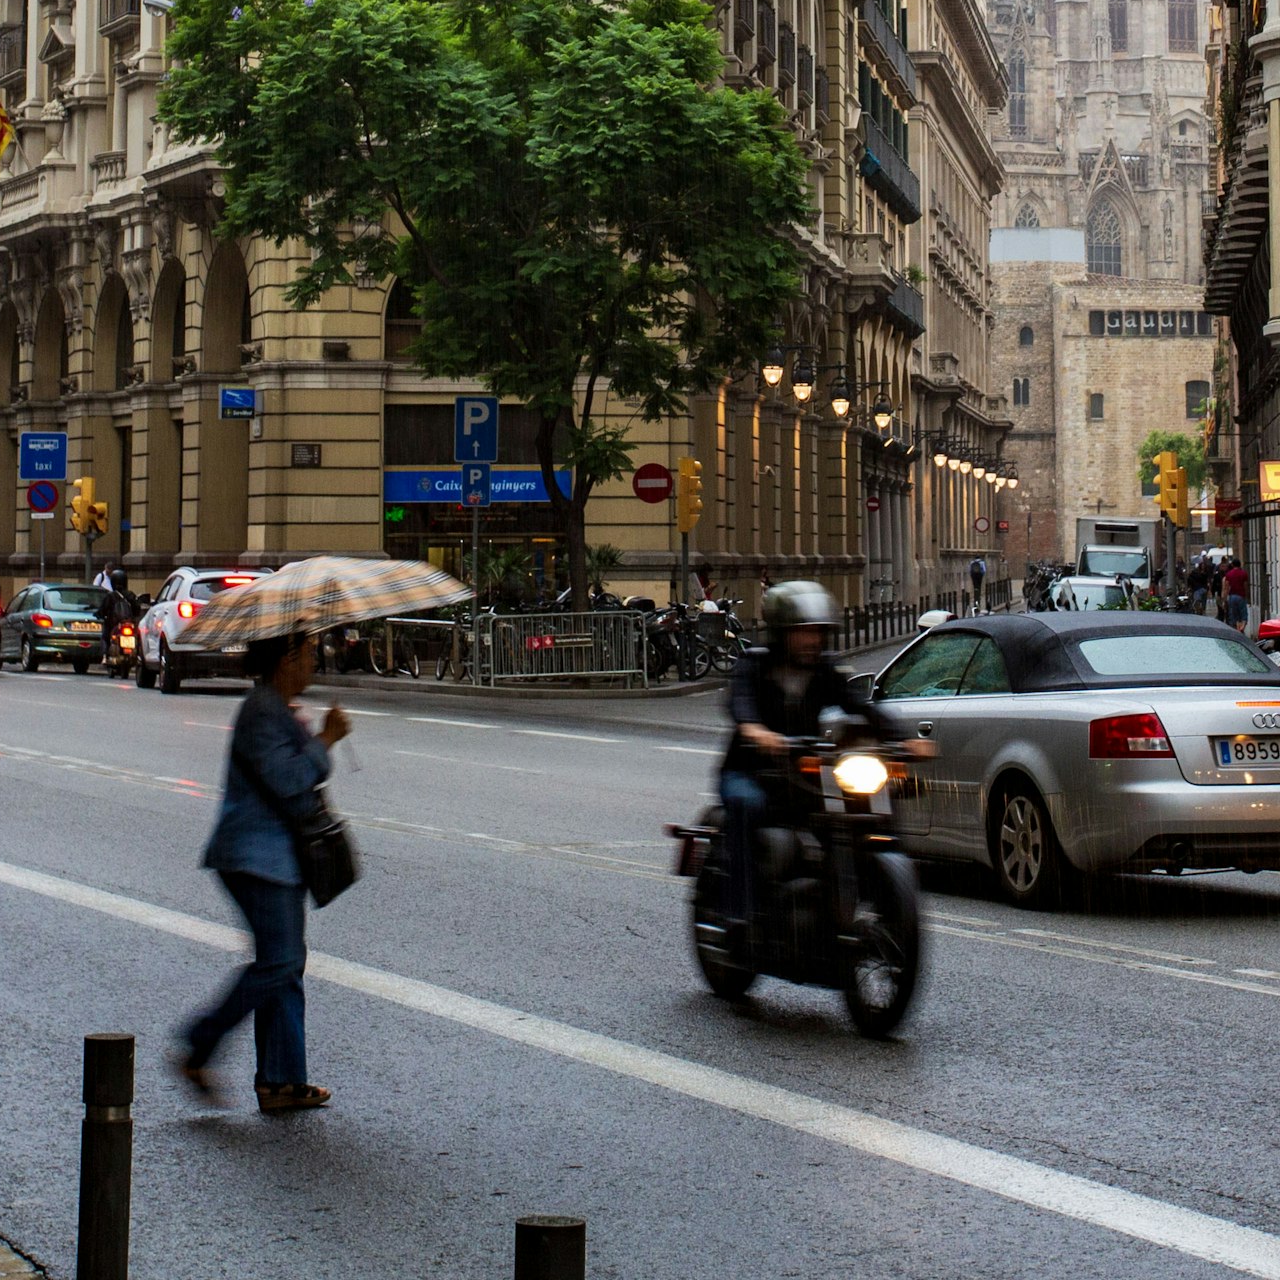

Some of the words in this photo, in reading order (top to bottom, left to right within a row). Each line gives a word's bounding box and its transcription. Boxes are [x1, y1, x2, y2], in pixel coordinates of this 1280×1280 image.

[463, 401, 490, 436] P
[35, 461, 53, 471] taxi
[469, 469, 483, 486] P
[1234, 742, 1280, 760] 8959
